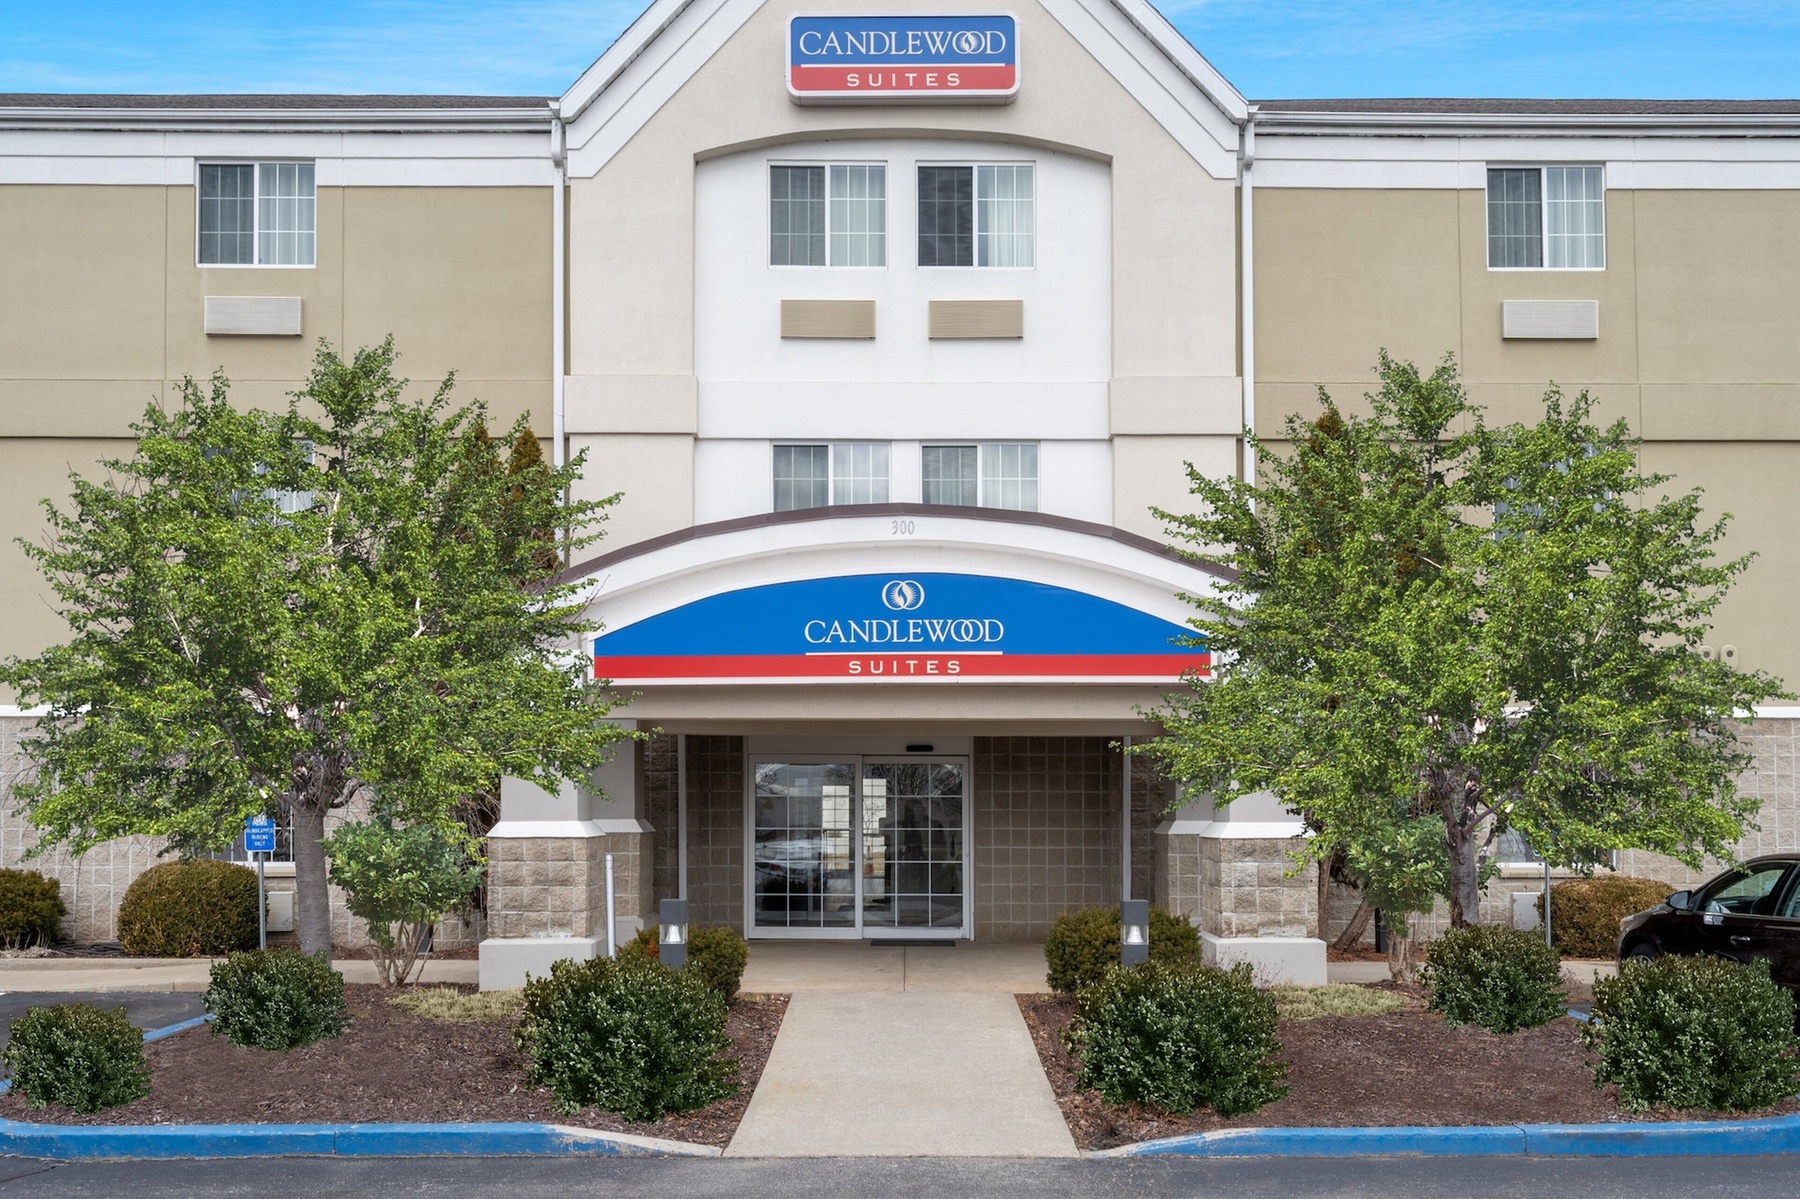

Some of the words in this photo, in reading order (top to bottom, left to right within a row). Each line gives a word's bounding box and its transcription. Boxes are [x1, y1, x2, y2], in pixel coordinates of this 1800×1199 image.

[800, 31, 1006, 55] CANDLEWOOD
[847, 73, 960, 87] SUITES
[891, 520, 915, 535] 300
[804, 619, 1004, 643] CANDLEWOOD
[848, 660, 961, 674] SUITES
